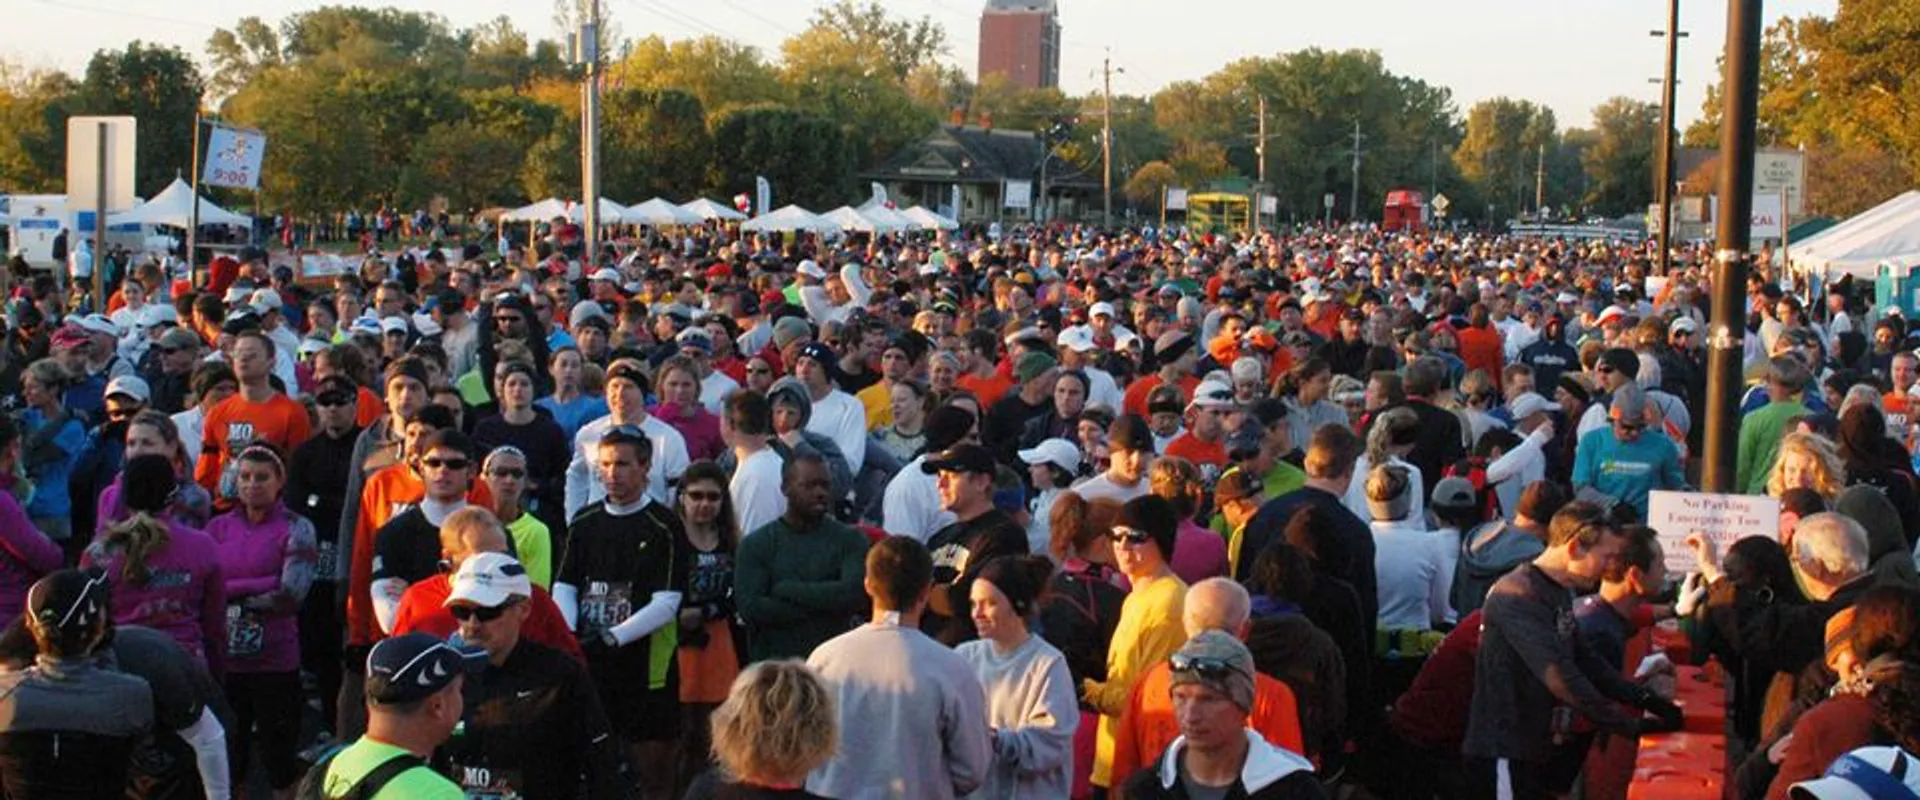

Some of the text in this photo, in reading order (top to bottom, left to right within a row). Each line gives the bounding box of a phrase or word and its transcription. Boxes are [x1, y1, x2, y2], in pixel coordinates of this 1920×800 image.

[230, 423, 253, 440] MO
[1683, 499, 1751, 513] No Parking
[1667, 512, 1761, 526] Emergency Tow
[591, 581, 609, 595] MO
[462, 766, 491, 787] MO
